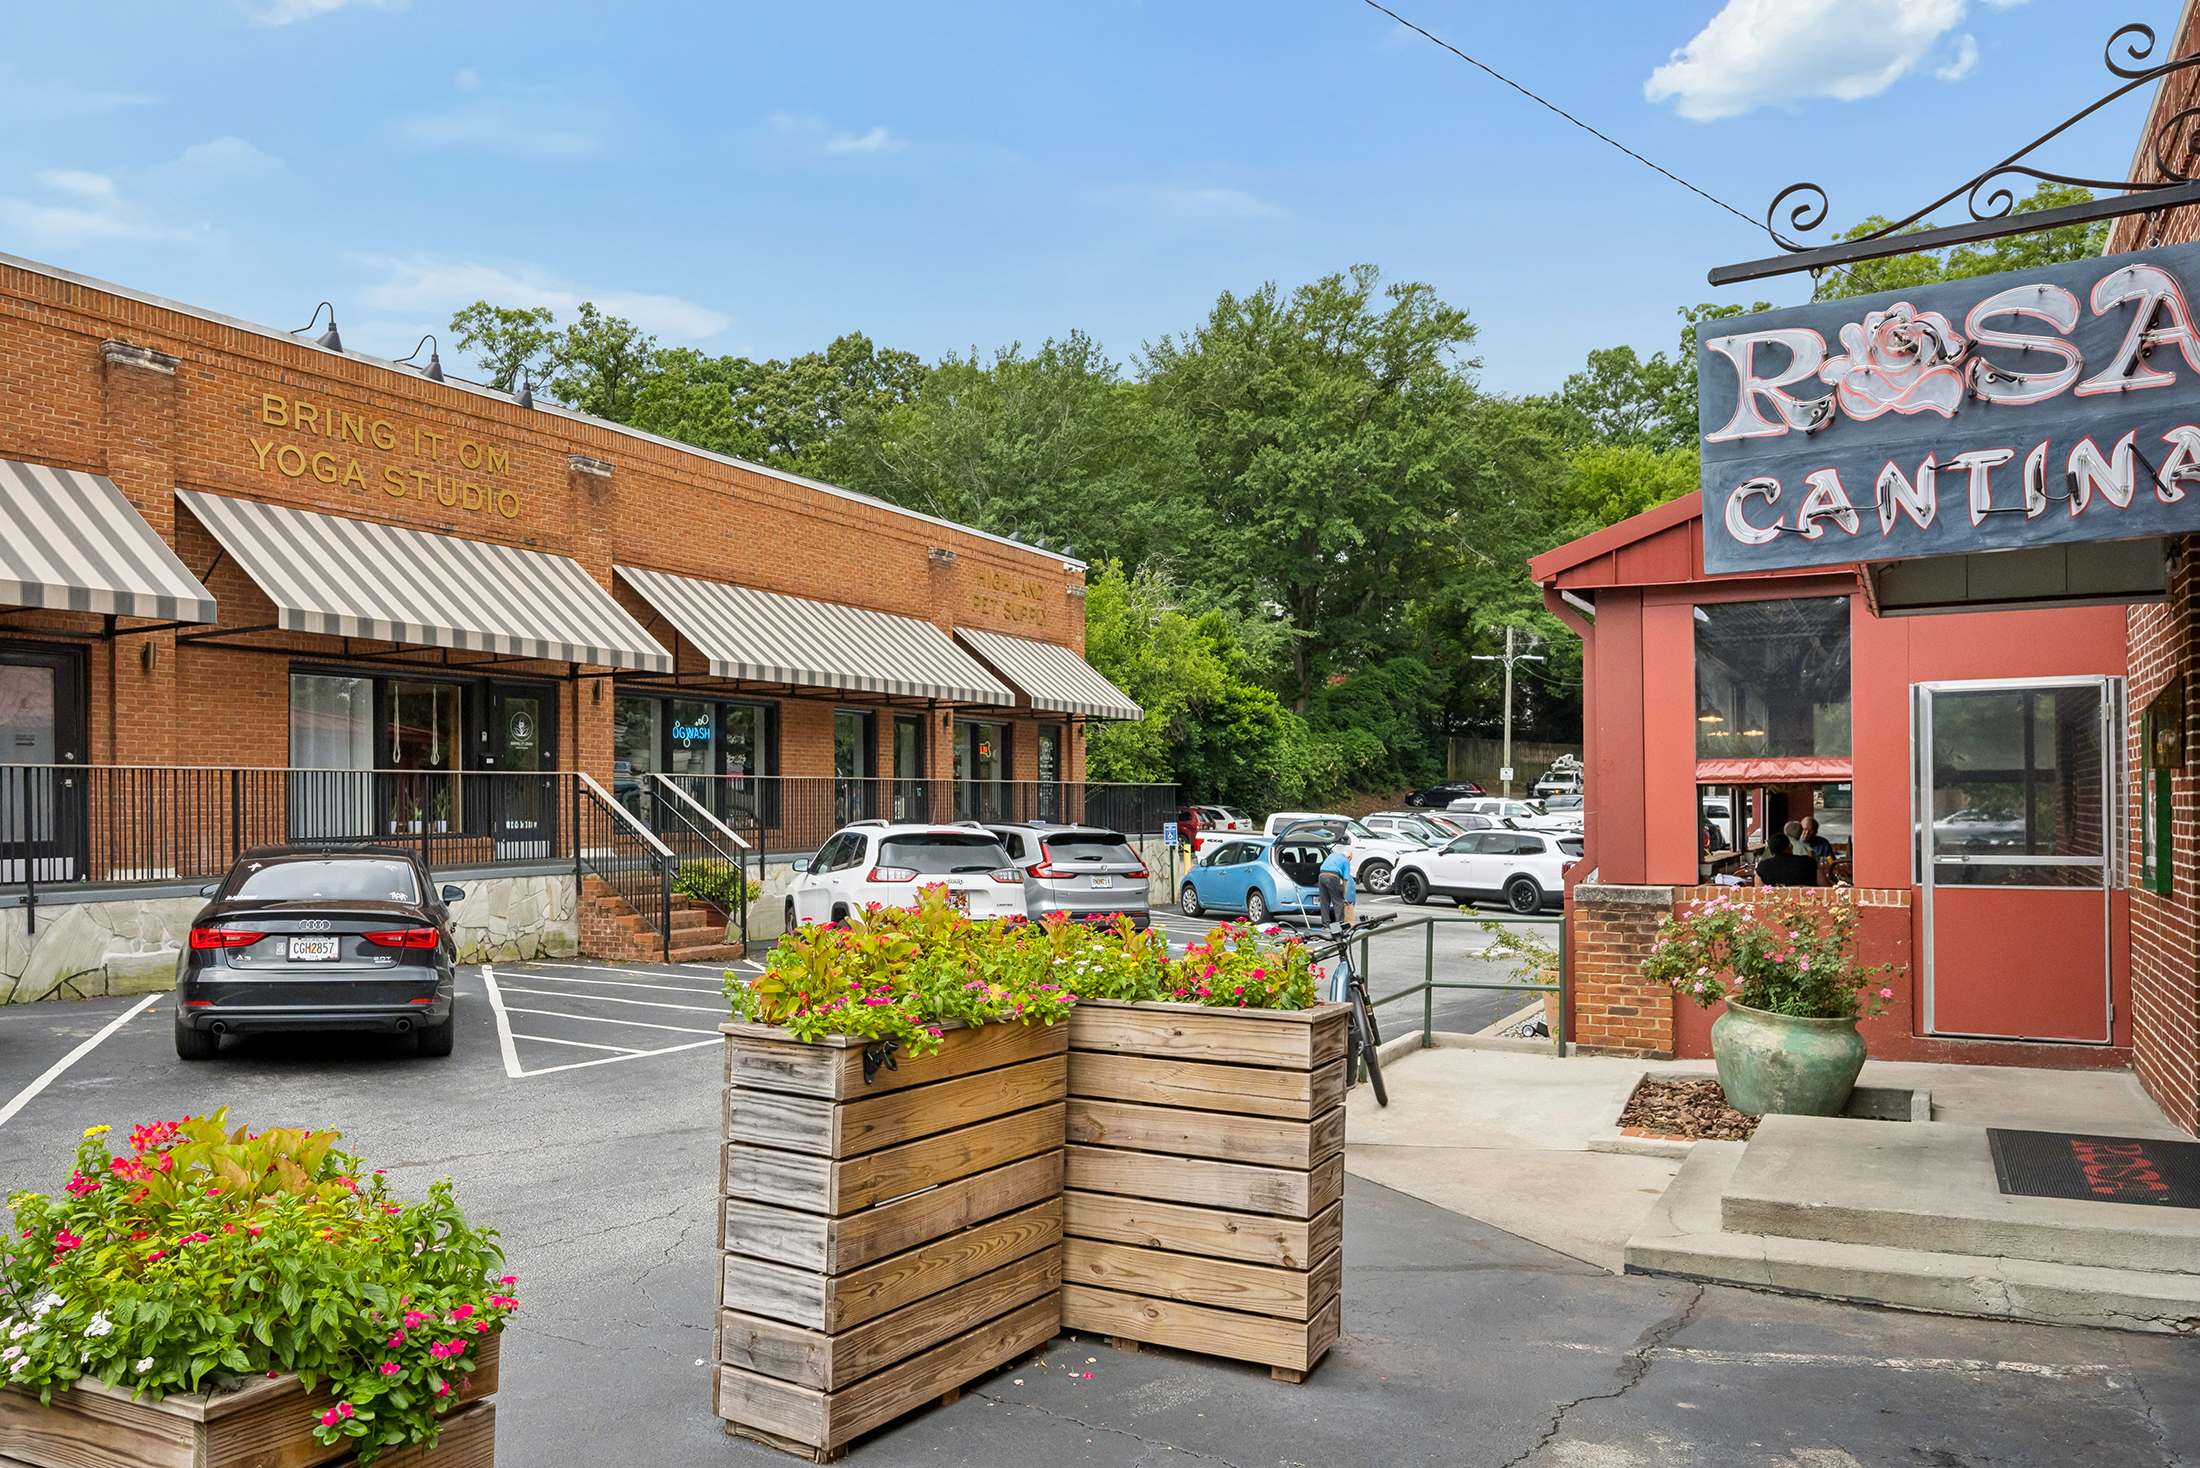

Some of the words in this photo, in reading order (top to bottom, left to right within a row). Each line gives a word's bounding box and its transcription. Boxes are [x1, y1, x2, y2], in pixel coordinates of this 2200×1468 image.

[262, 392, 395, 450] BRING
[414, 428, 445, 461] IT
[458, 440, 510, 477] OM
[249, 437, 368, 491] YOGA
[382, 465, 520, 519] STUDIO
[1725, 424, 2200, 545] CANTINA
[971, 594, 997, 616] PET
[1003, 601, 1049, 626] SUPPLY
[977, 567, 1044, 601] HIGHLAND
[293, 942, 335, 954] CGH2857
